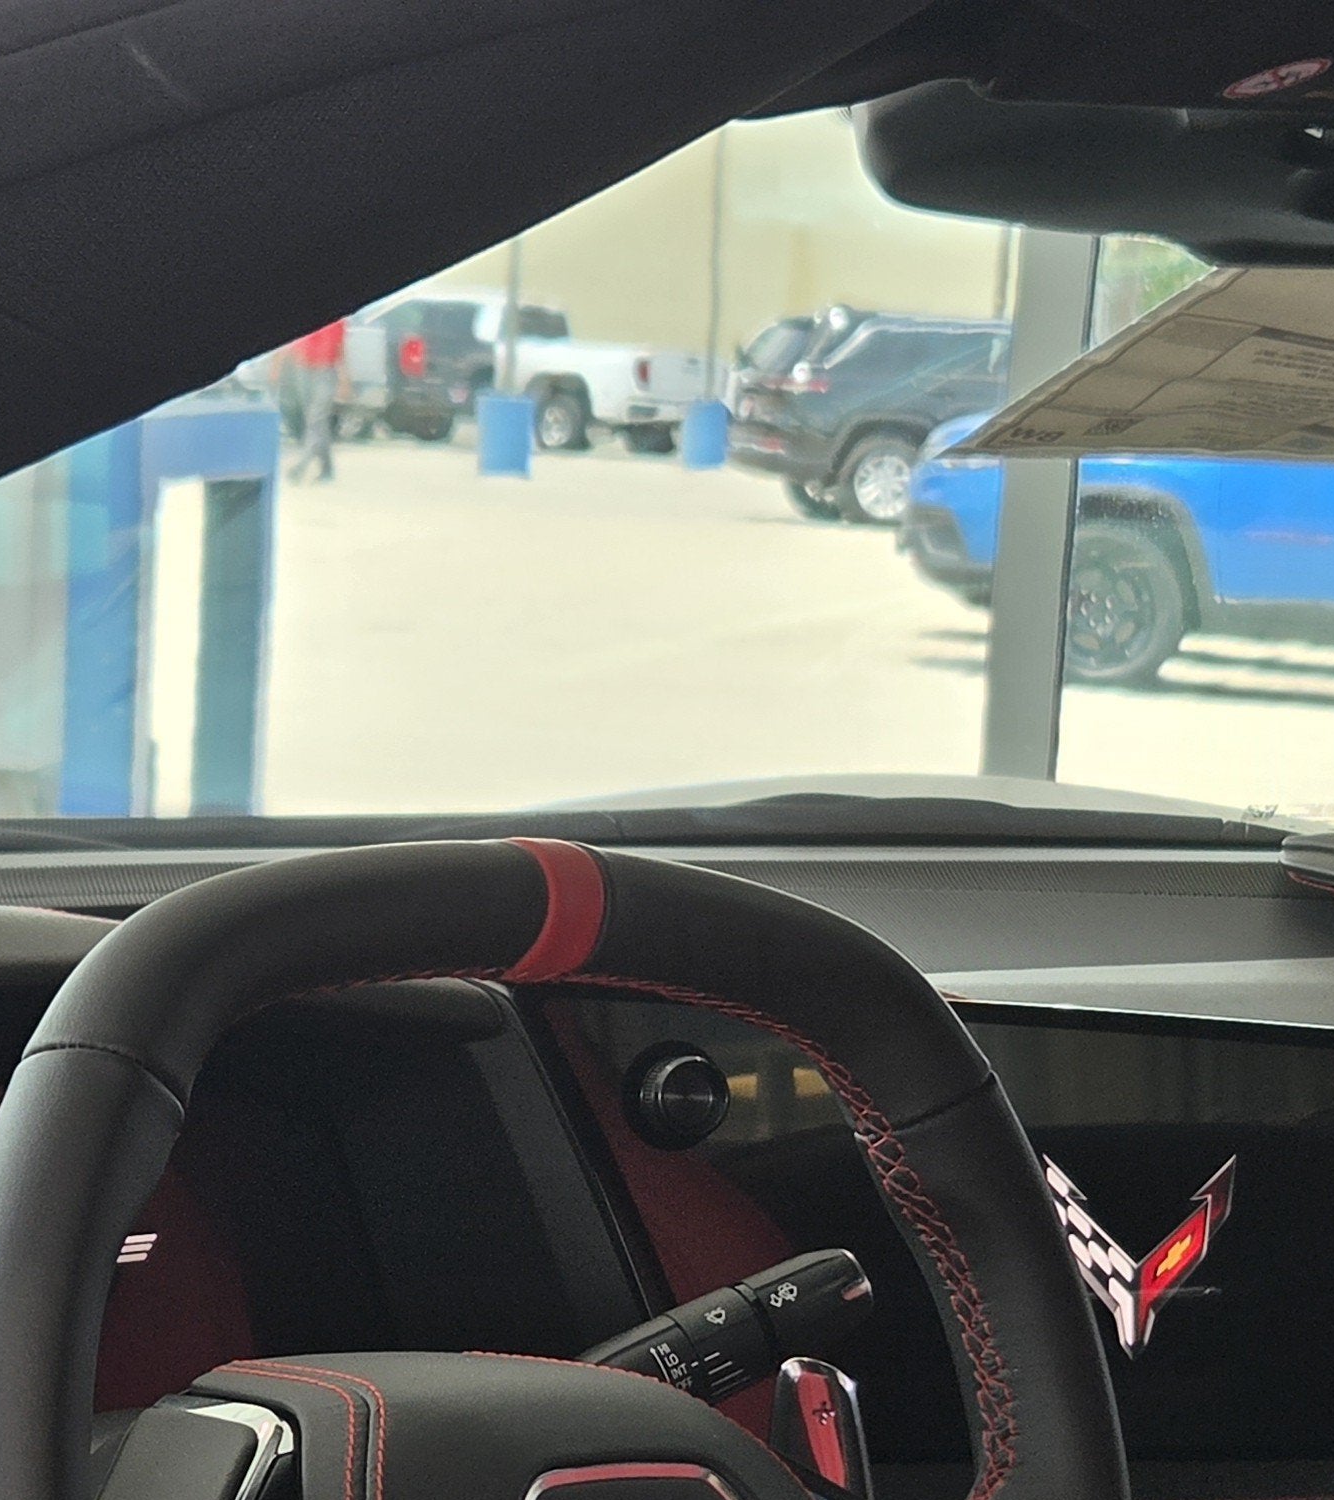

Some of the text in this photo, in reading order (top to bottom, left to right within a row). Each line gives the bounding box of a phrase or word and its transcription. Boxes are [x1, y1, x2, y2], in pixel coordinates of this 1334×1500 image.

[656, 1342, 671, 1356] HI
[664, 1353, 680, 1368] LO
[670, 1363, 687, 1380] INT
